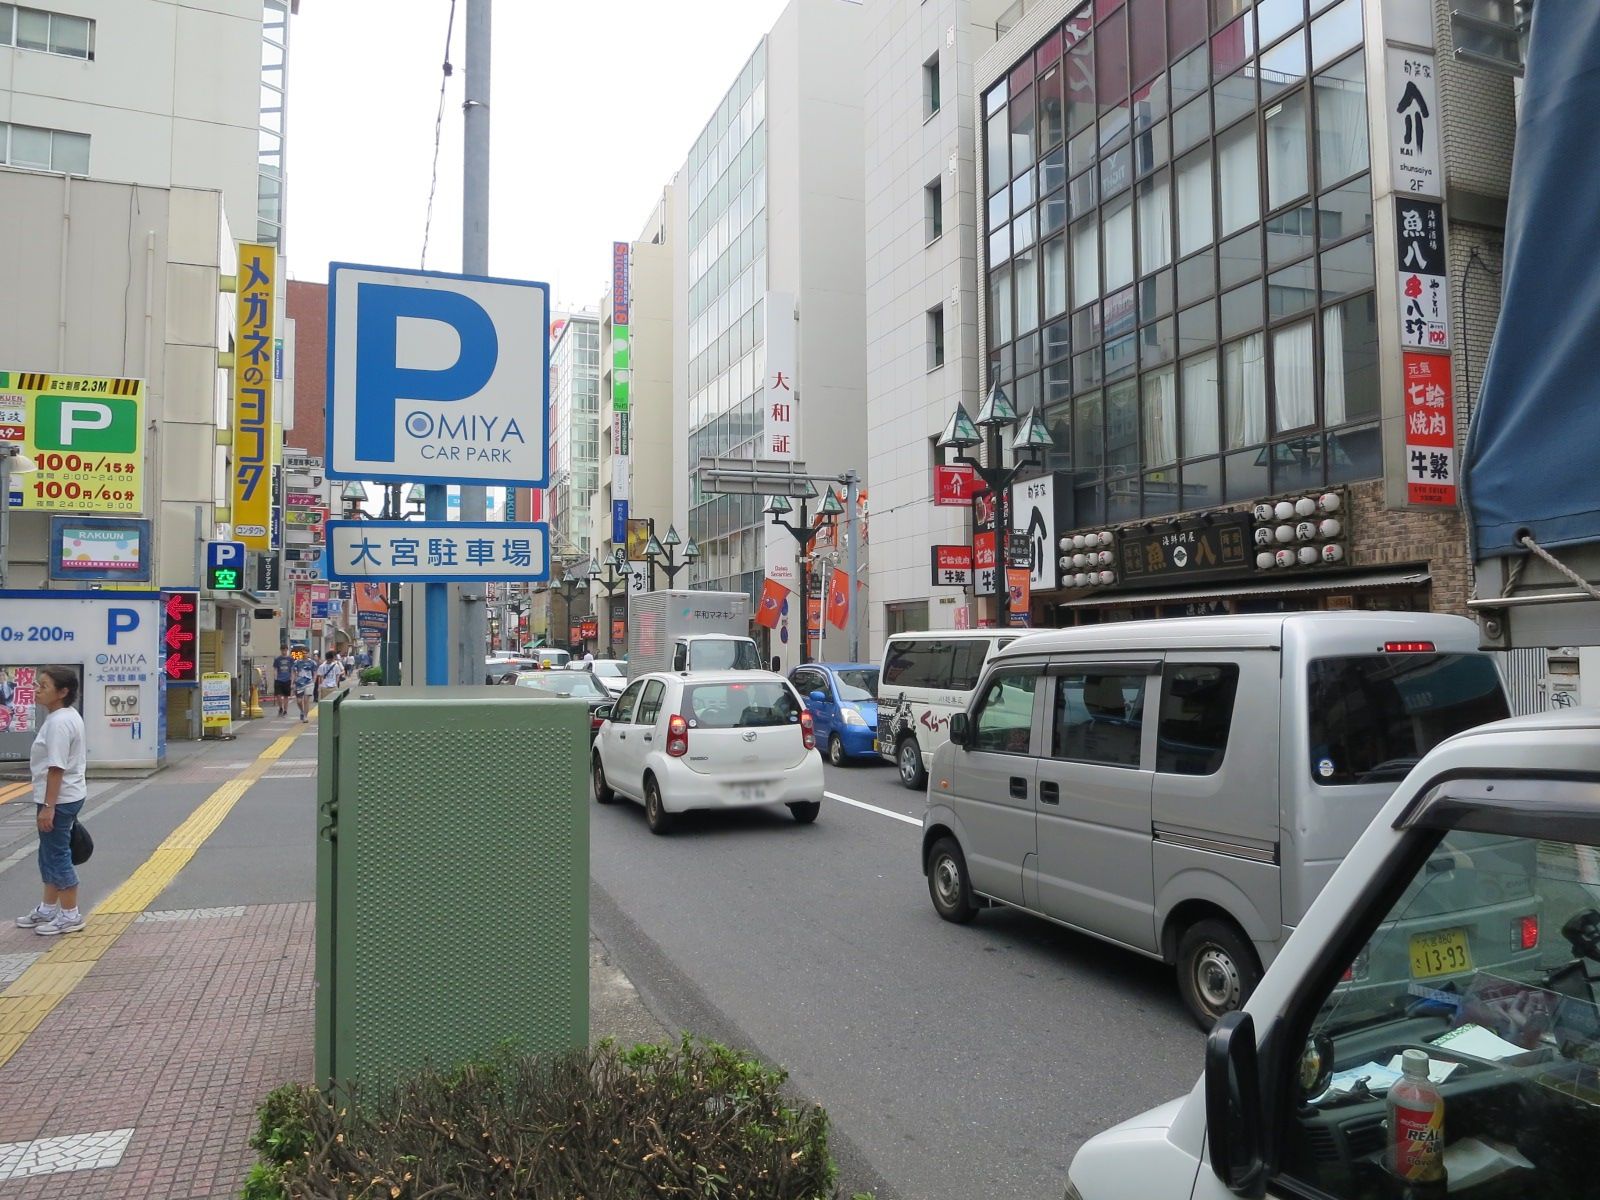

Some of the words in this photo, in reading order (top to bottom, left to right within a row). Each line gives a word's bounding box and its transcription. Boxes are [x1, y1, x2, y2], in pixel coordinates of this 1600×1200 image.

[1400, 148, 1413, 156] KAI
[1400, 163, 1432, 177] shunsaiya
[1410, 179, 1424, 192] 2F
[1402, 209, 1428, 270] 魚八
[237, 257, 270, 501] メガネのヨコタ
[355, 282, 498, 462] P
[1408, 381, 1446, 408] 七輪
[771, 371, 791, 454] 大和証
[60, 401, 112, 446] P
[405, 410, 525, 444] OMIYA
[1409, 411, 1446, 436] 焼肉
[34, 453, 136, 474] 100円/15分
[420, 444, 460, 461] CAR
[466, 447, 512, 463] PARK
[1411, 450, 1449, 480] 牛繁
[33, 481, 135, 501] 100円/60分
[79, 531, 124, 540] RAKUUN
[237, 526, 264, 535] コンタクト
[217, 544, 235, 565] P
[349, 536, 532, 567] 大宮駐車場
[976, 549, 994, 564] 七輪
[215, 569, 236, 588] 空
[945, 570, 966, 583] 牛繁
[694, 609, 736, 621] 平和マネキン
[28, 626, 74, 642] 200円
[107, 608, 140, 645] P
[96, 653, 147, 665] OMIYA
[96, 674, 147, 682] 大宮駐車場
